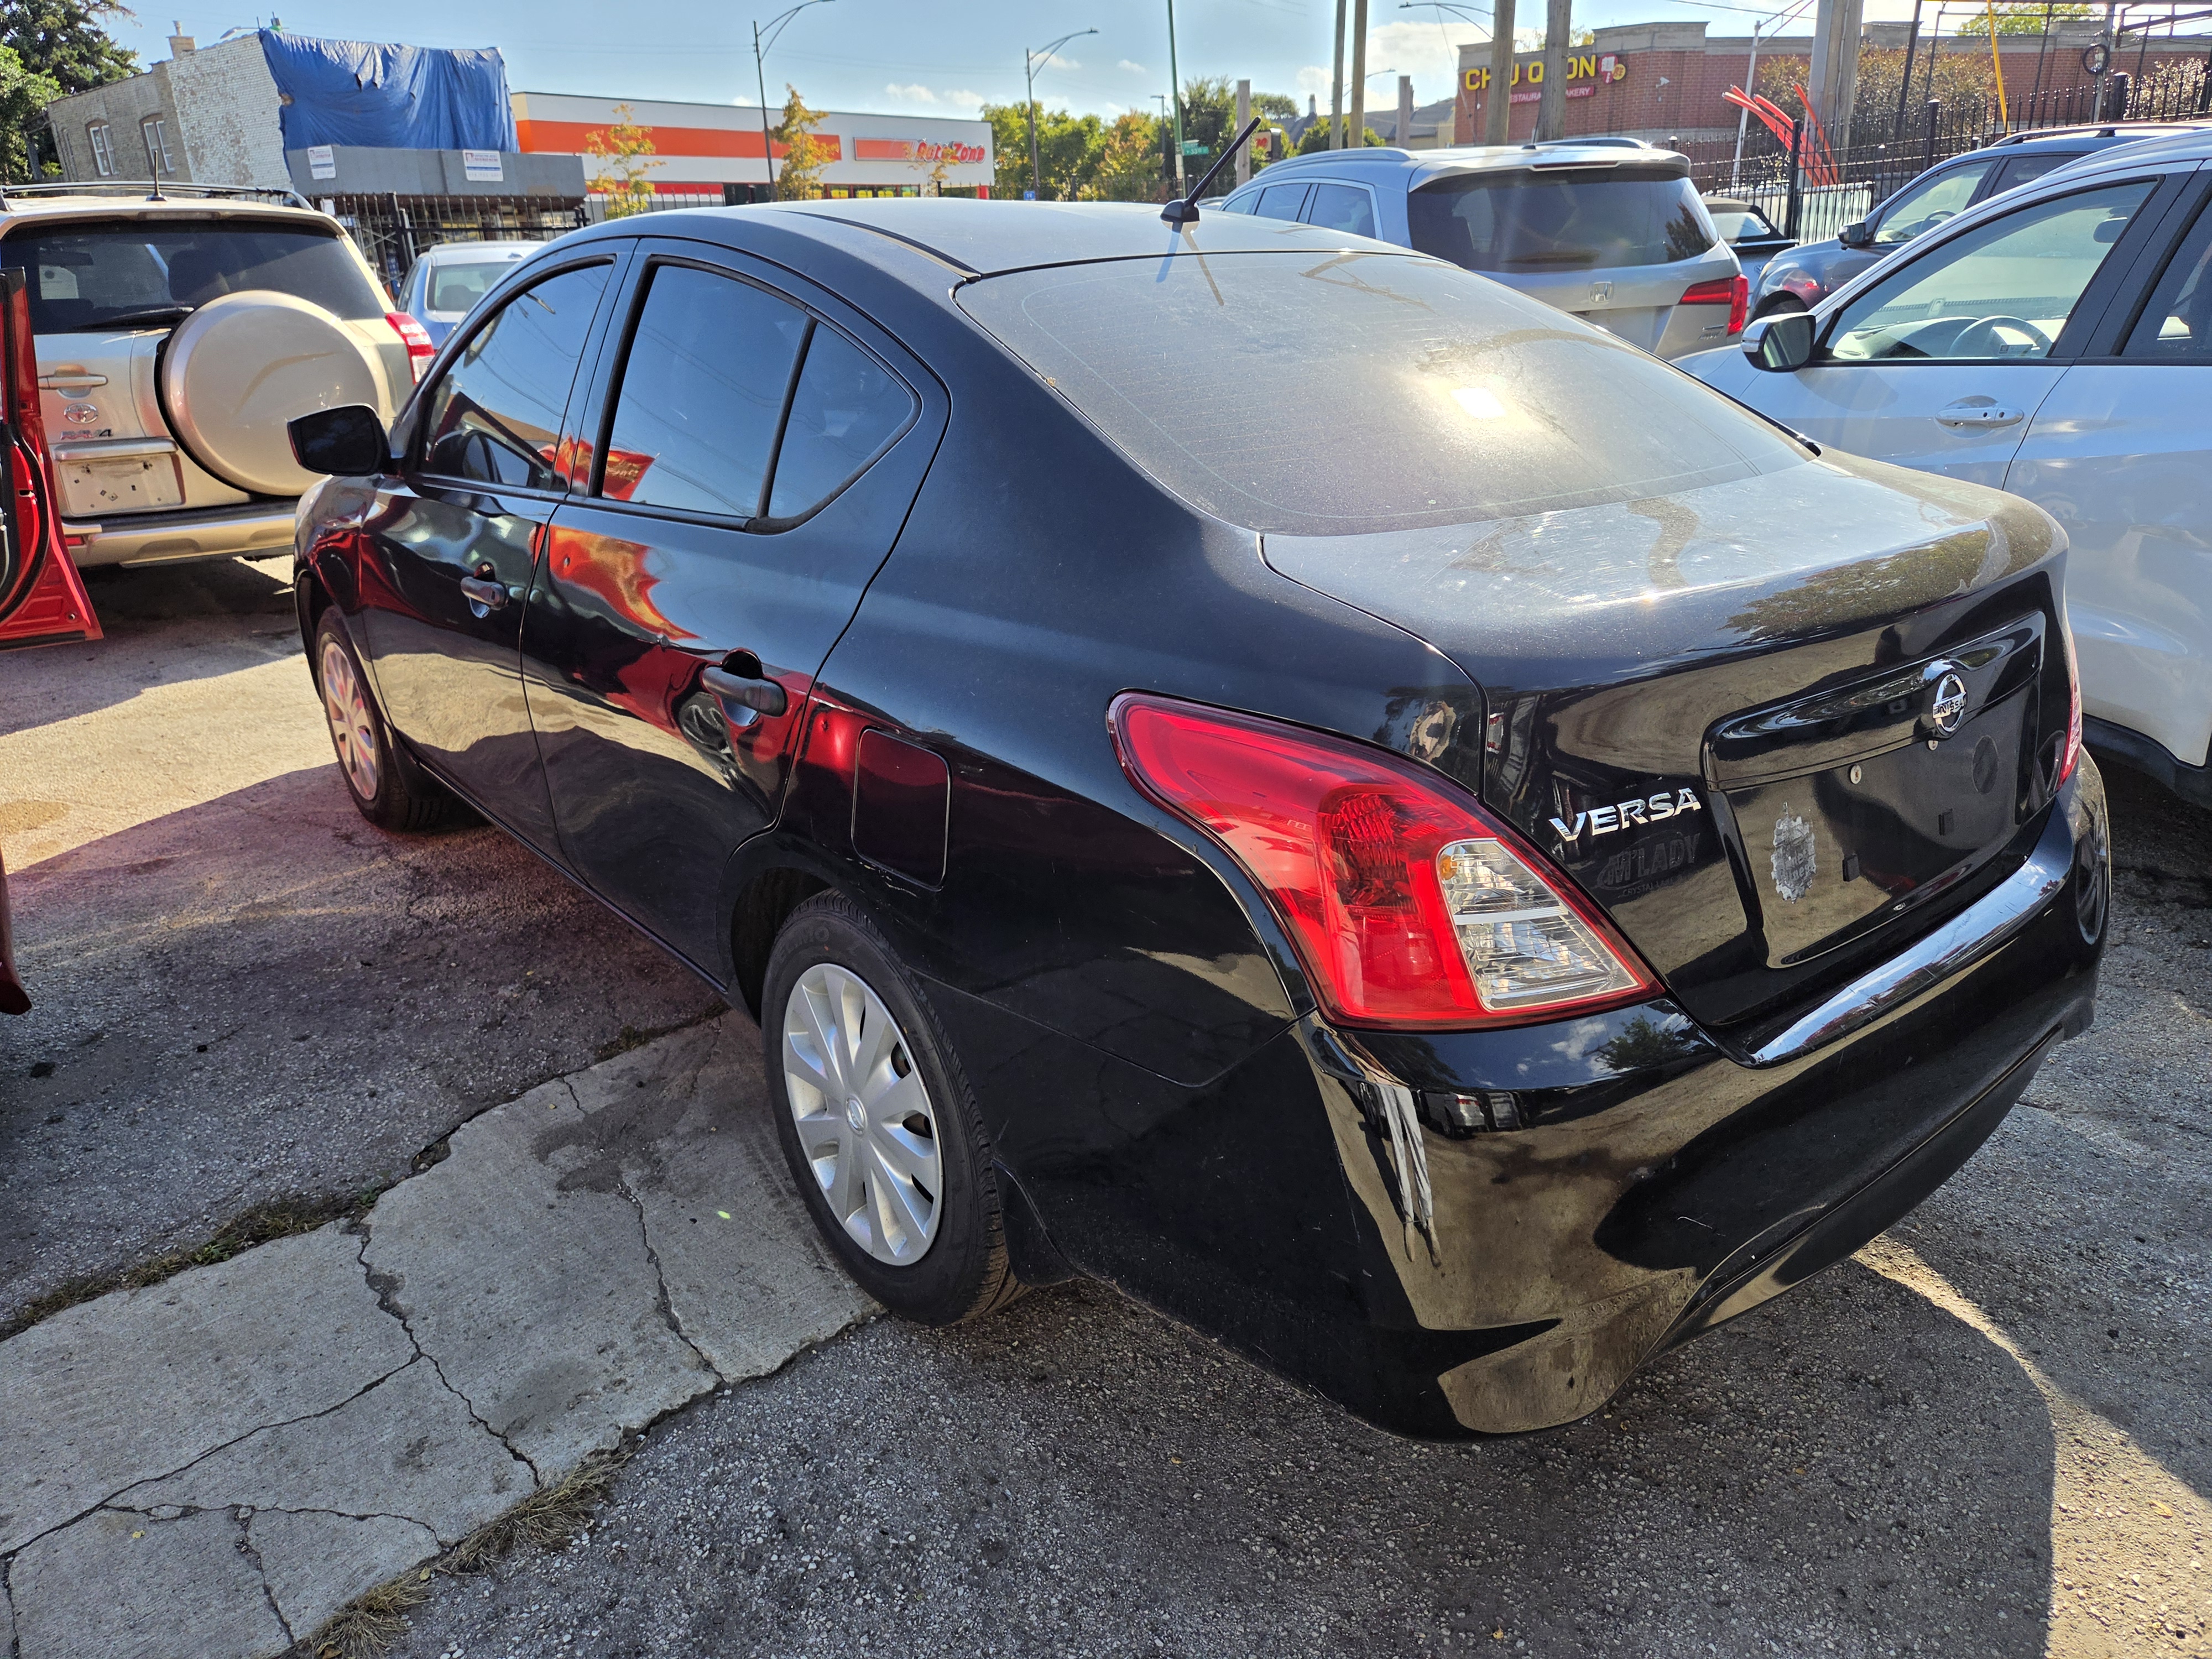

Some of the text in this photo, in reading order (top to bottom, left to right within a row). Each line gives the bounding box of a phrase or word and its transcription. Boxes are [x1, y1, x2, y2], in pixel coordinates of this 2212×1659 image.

[1465, 64, 1519, 90] CHU
[1528, 54, 1597, 84] QON
[1565, 87, 1590, 97] AKERY
[1939, 697, 1967, 715] NISSAN
[1548, 787, 1702, 842] VERSA
